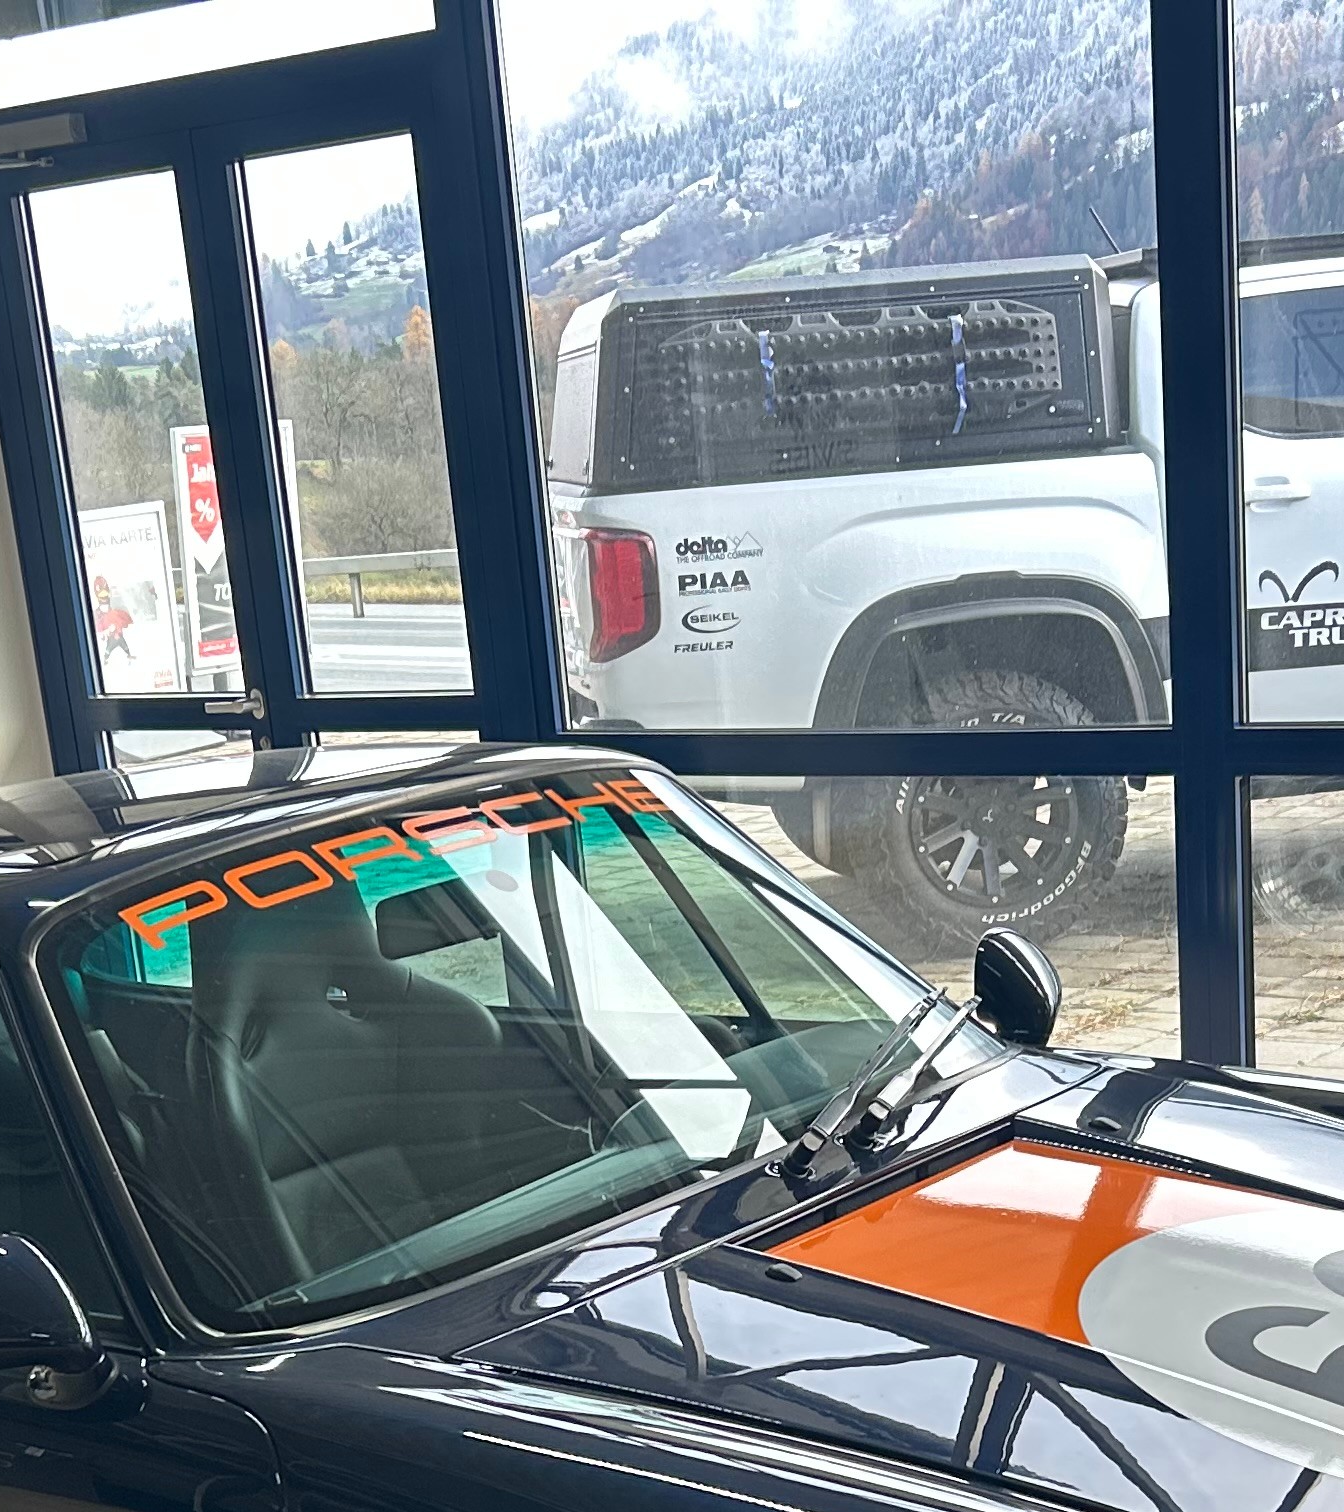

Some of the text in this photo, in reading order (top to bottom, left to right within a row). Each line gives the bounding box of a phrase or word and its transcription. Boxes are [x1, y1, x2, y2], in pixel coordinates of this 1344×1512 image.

[675, 536, 728, 556] delta
[677, 569, 751, 591] PIAA
[689, 612, 740, 624] SEIKEL
[673, 640, 734, 654] FREULER
[117, 778, 674, 950] PORSCHE
[981, 840, 1092, 925] BFGoodrich
